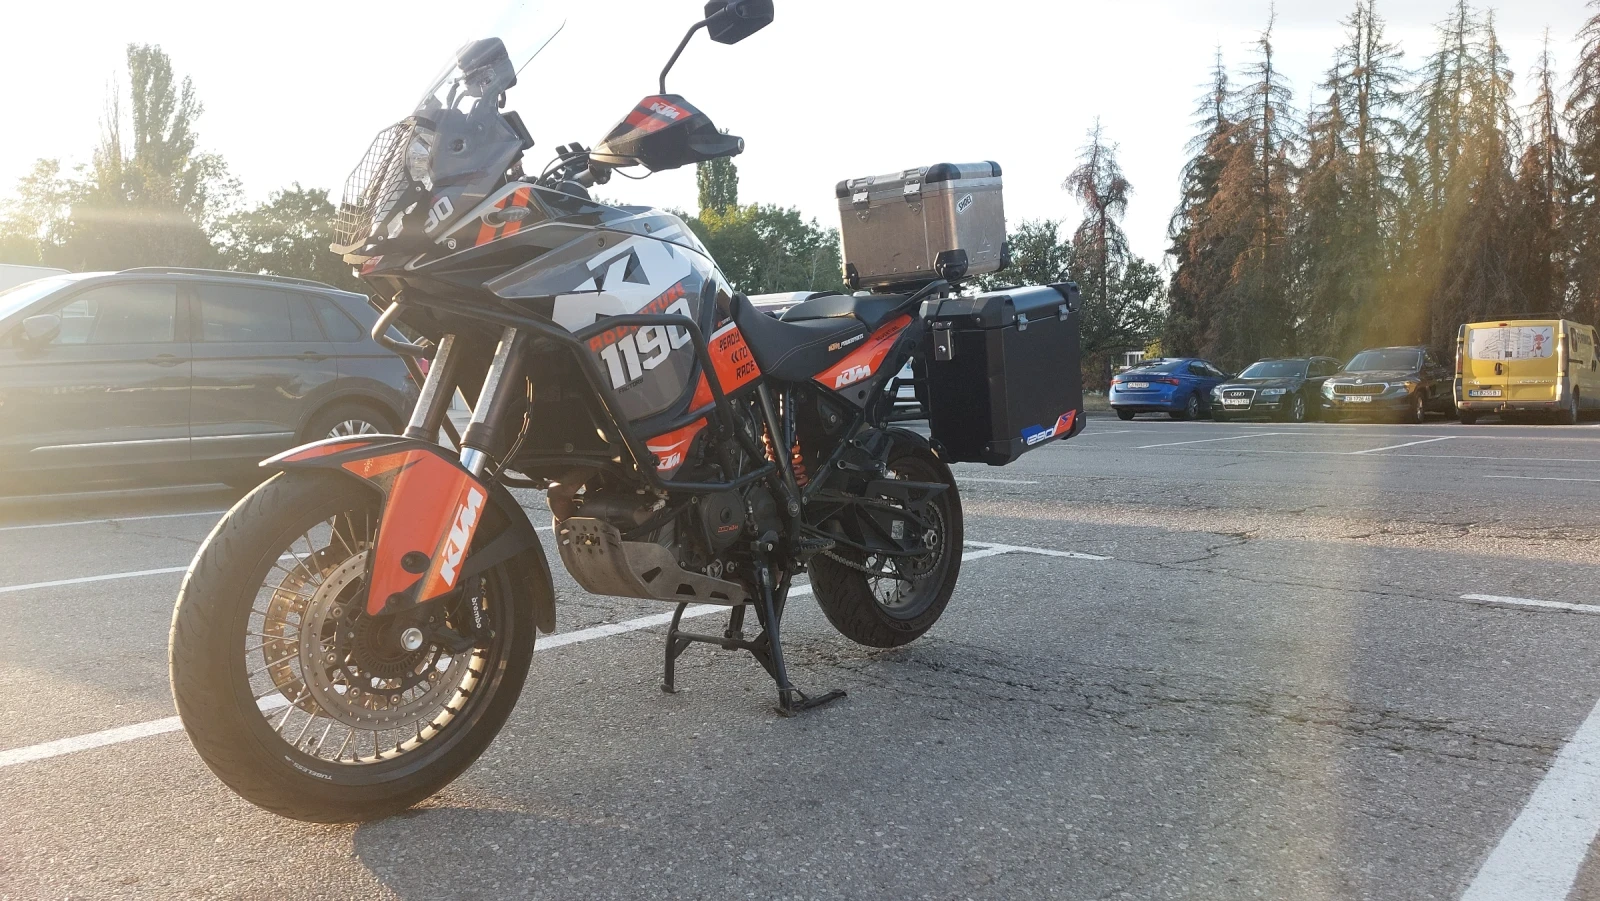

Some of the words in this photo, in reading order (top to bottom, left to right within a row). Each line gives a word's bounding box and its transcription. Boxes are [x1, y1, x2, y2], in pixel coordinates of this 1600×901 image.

[650, 102, 681, 119] KTM
[958, 195, 972, 211] SHOEI
[600, 297, 692, 390] 1190
[719, 331, 741, 352] READY
[736, 360, 755, 380] RACE
[835, 364, 871, 389] KTM
[618, 377, 644, 395] FACTORY
[656, 452, 681, 470] KTM
[440, 486, 484, 587] KTM
[471, 597, 482, 629] brembo
